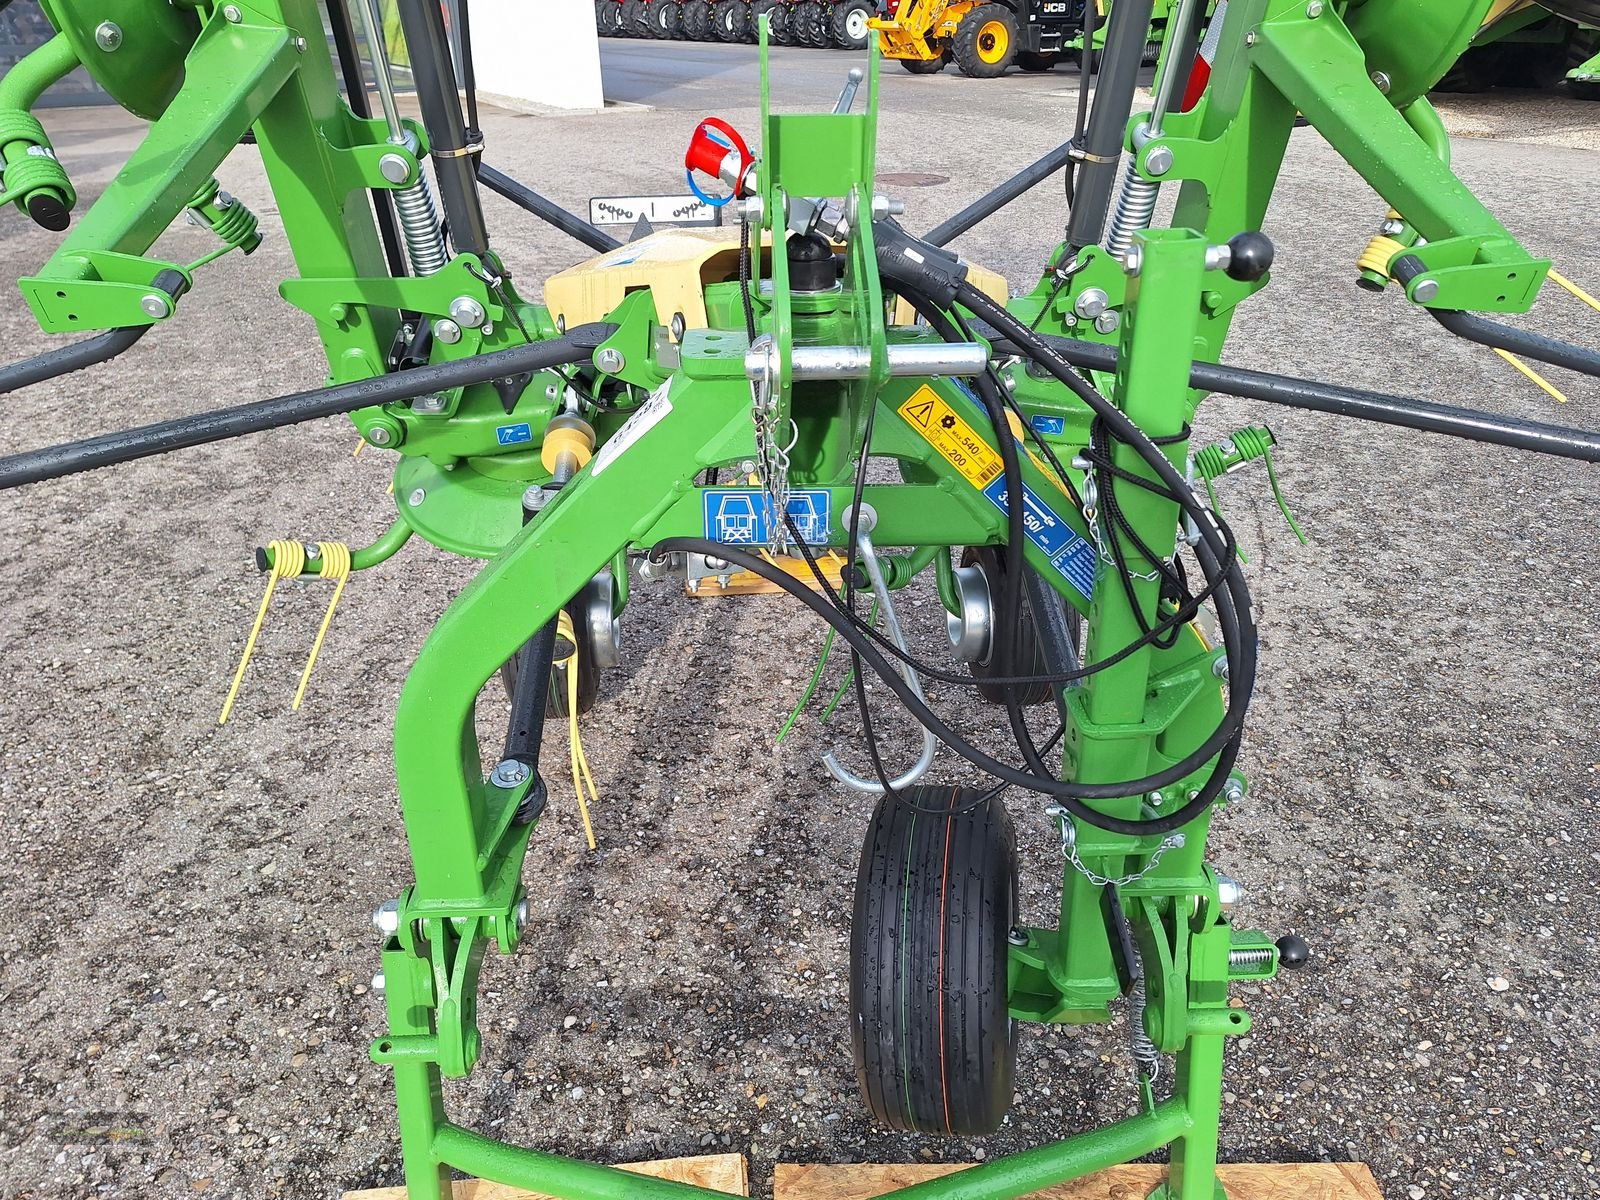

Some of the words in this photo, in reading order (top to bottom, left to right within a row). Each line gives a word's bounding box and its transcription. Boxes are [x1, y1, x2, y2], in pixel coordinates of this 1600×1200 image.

[1044, 3, 1066, 12] JCB
[949, 449, 966, 466] 200
[1039, 535, 1050, 545] min
